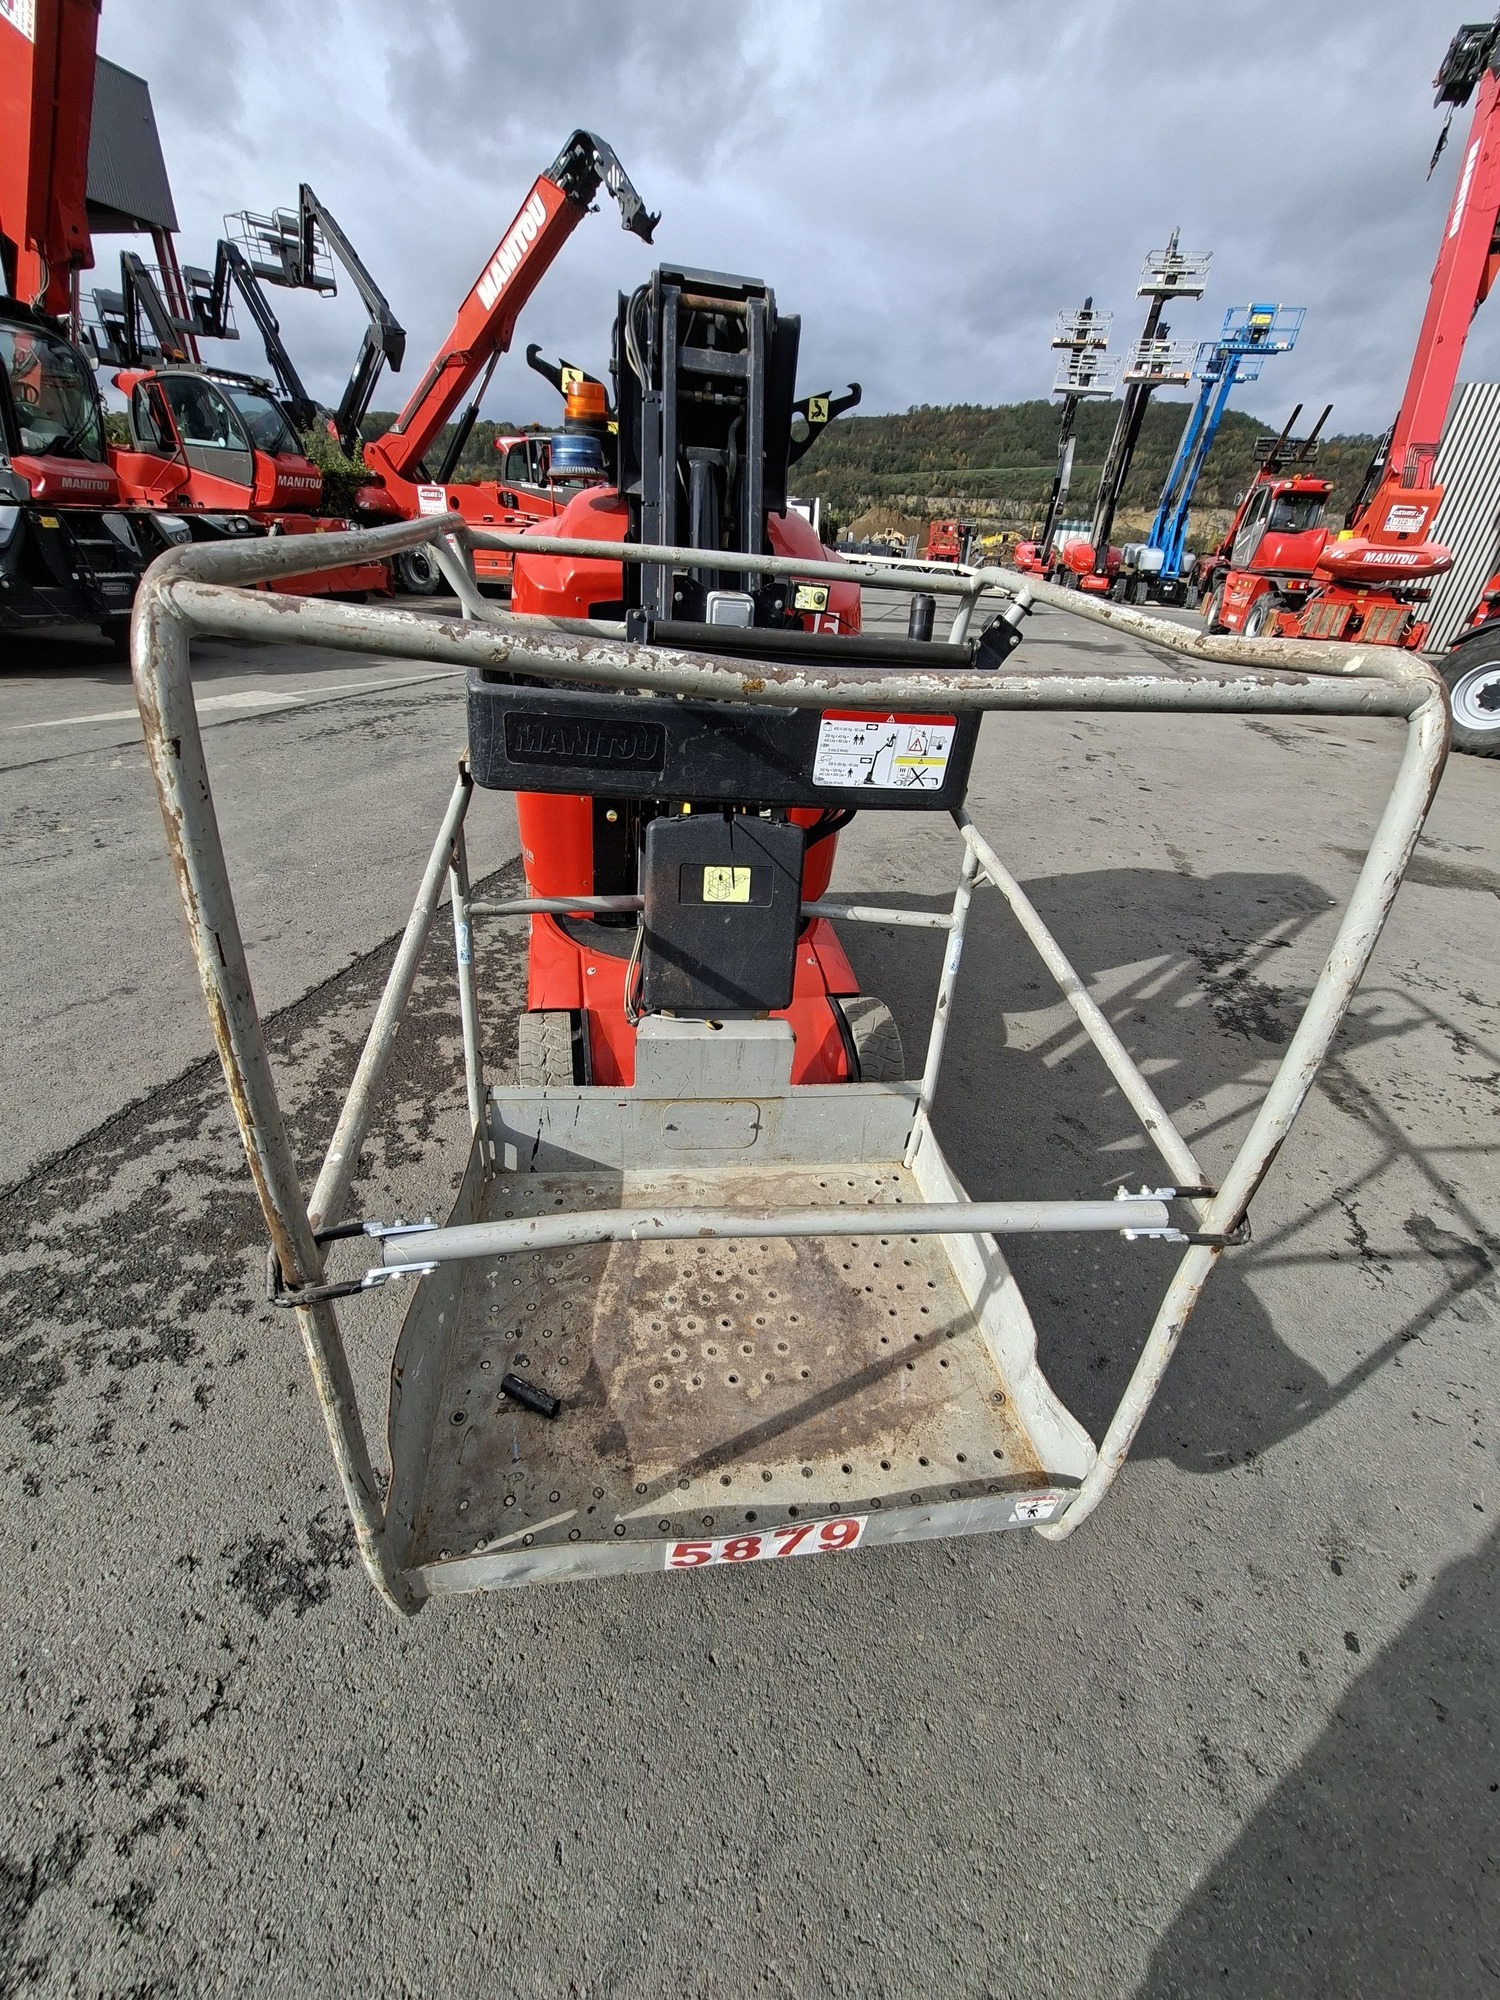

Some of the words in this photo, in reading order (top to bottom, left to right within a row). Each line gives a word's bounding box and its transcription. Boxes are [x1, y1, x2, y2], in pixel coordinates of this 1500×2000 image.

[476, 190, 547, 312] MANITOU
[61, 477, 110, 491] MANITOU
[277, 474, 323, 489] MANITOU
[1363, 552, 1418, 565] MANITOU
[514, 723, 659, 761] MANITOU
[669, 1518, 861, 1568] 5879
